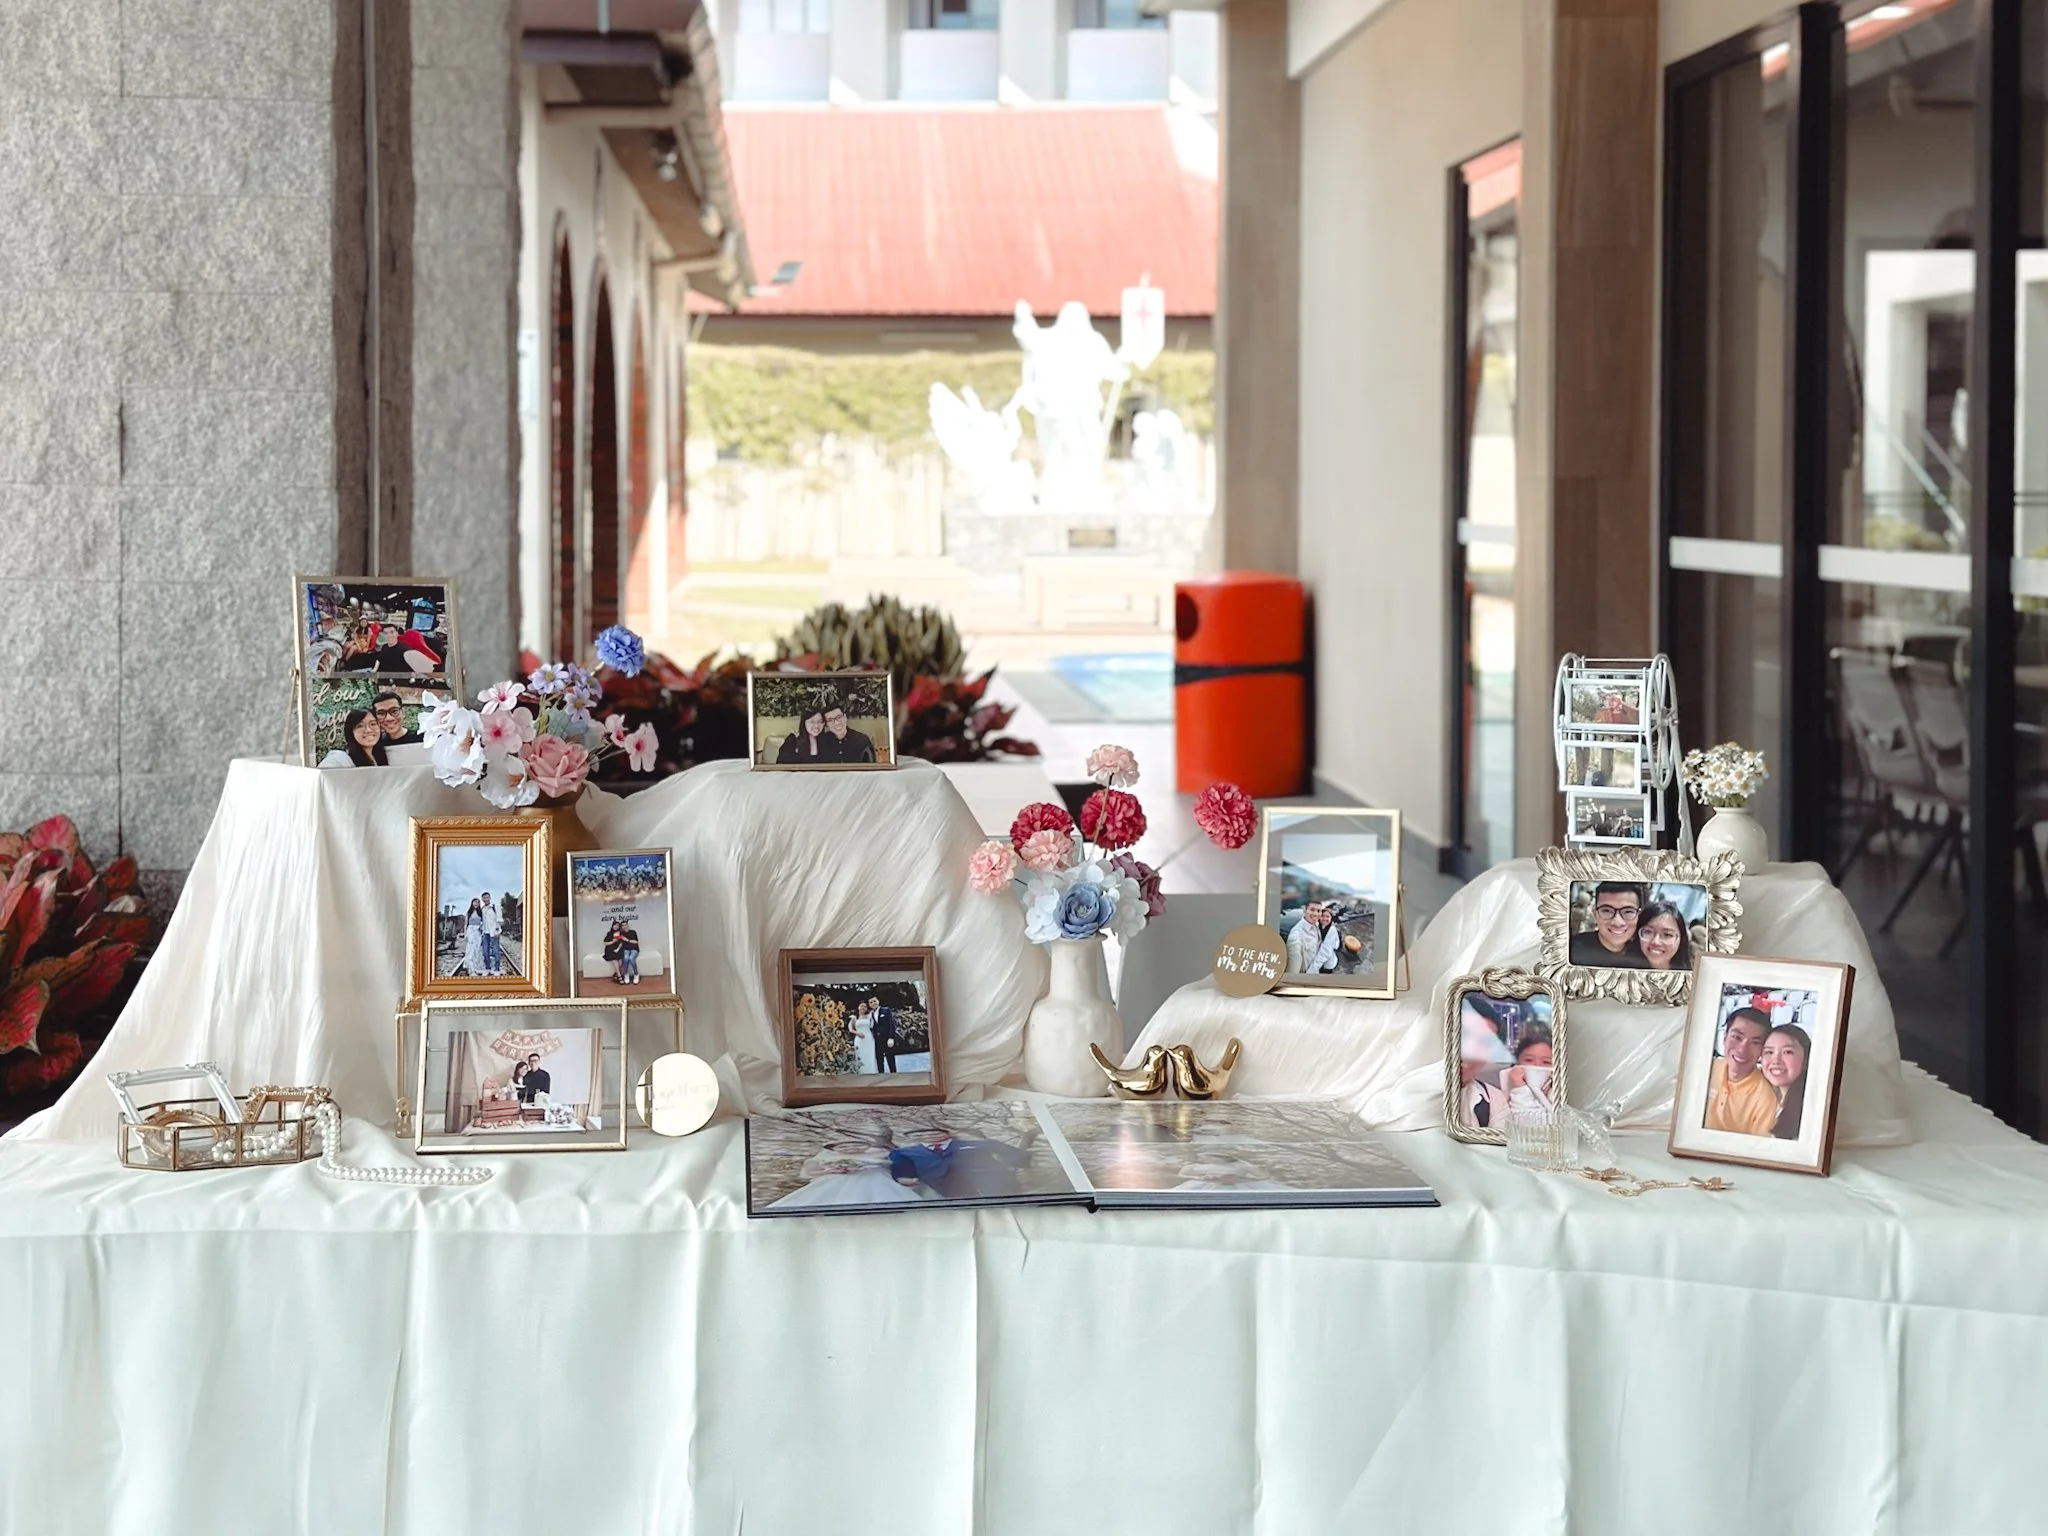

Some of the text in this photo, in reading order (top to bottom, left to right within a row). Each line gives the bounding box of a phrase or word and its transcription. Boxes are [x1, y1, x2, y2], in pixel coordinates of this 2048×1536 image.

[1222, 945, 1235, 956] TO
[1238, 947, 1256, 960] THE
[1216, 955, 1277, 980] Mr & Mrs
[504, 1031, 550, 1045] HAPPY
[493, 1039, 561, 1059] BIRTDAY
